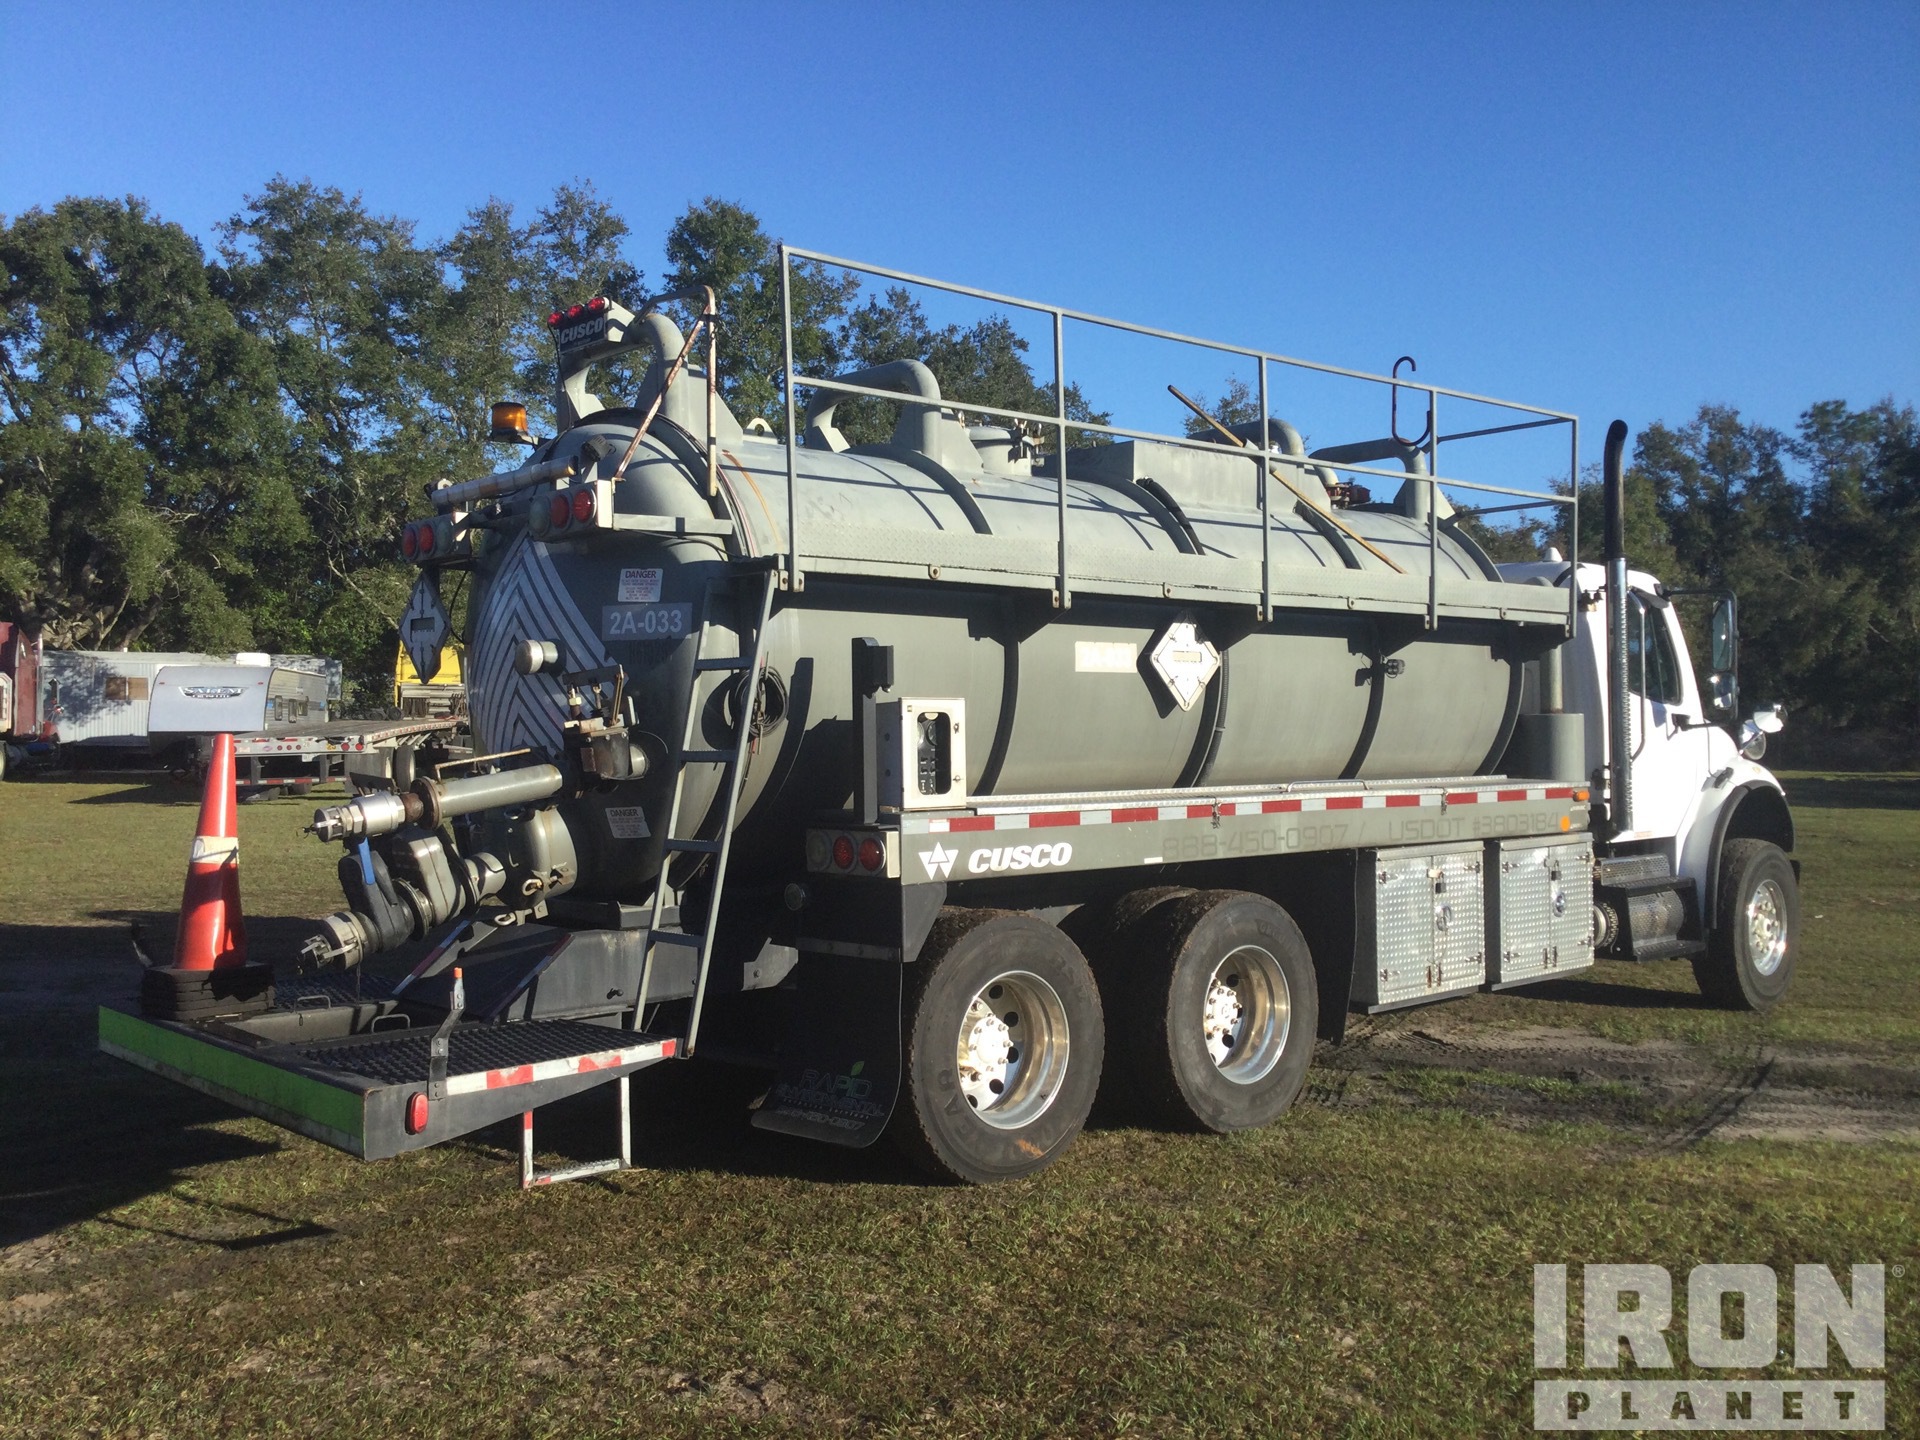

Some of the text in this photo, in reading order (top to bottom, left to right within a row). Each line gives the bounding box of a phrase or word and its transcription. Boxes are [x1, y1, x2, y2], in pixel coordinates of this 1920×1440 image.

[561, 317, 604, 344] CUSCO
[625, 570, 657, 579] DANGER
[609, 609, 683, 635] 2A-033
[611, 809, 639, 817] DANGER
[1163, 824, 1349, 860] 888-450-0907
[1389, 817, 1465, 842] USDOT
[1472, 812, 1559, 838] #3803184
[968, 842, 1073, 874] CUSCO
